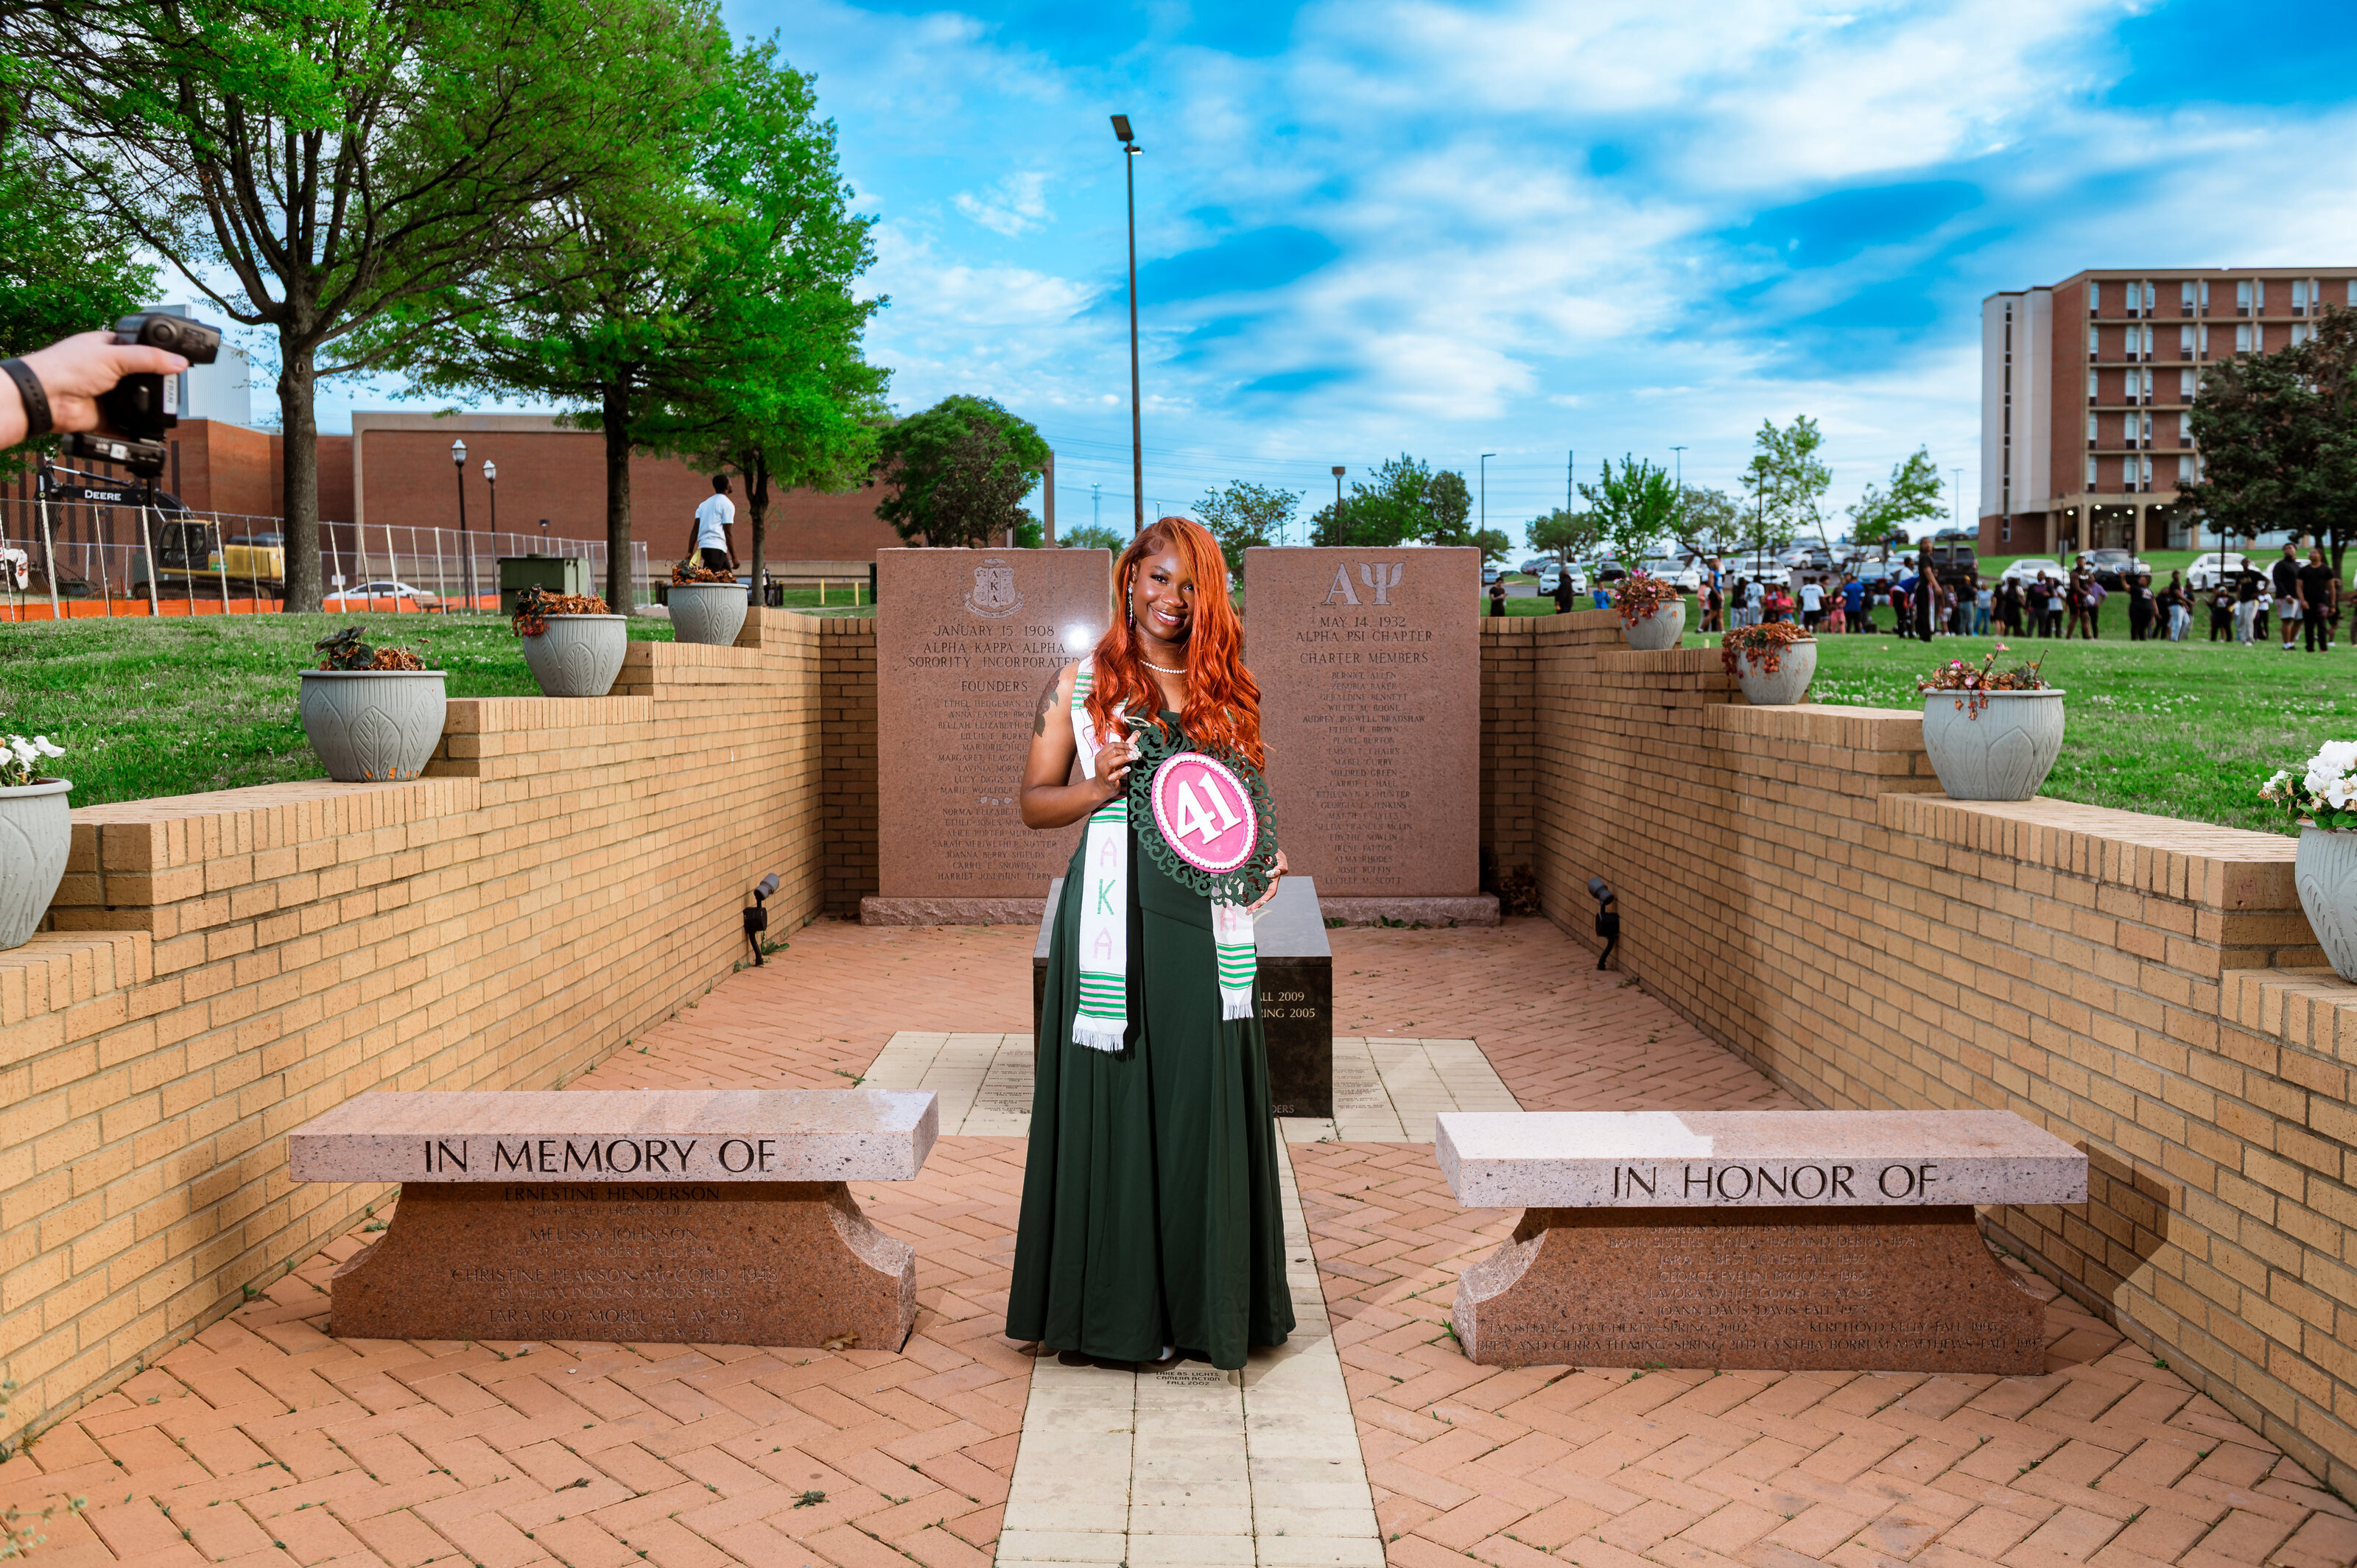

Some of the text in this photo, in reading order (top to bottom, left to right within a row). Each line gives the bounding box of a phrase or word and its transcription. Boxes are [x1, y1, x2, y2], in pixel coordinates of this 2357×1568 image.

[84, 489, 122, 502] DEERE
[1320, 616, 1346, 627] MAY
[1379, 616, 1406, 627] 1932
[932, 625, 993, 638] JANUARY
[1025, 625, 1054, 638] 1908
[1296, 631, 1433, 642] ALPHA PSI CHAPTER
[924, 642, 1065, 654] ALPHA KAPPA ALPHA
[1300, 653, 1428, 664] CHARTER MEMBERS
[1332, 672, 1397, 680] BERNICE ALLEN
[961, 681, 1028, 692] FOUNDERS
[944, 700, 1039, 708] ETHEL HEDGEMAN LYL
[949, 711, 1008, 719] ANNA EASTER
[960, 732, 1029, 741] LILLIE BURKE
[1330, 769, 1397, 777] MILDRED GREEN
[955, 776, 1004, 784] LUCY DIGGS
[941, 787, 967, 795] MARIE
[943, 808, 1021, 816] NORMA ELIZABETH
[1176, 772, 1242, 845] 41
[1329, 812, 1399, 820] MATTIE LYLES
[952, 862, 1037, 870] CARRIE SNOWDEN
[938, 872, 1052, 881] HARRIET JOSEPHINE TERRY
[1278, 991, 1304, 1002] 2009
[1290, 1008, 1316, 1018] 2005
[424, 1139, 776, 1173] IN MEMORY OF
[1613, 1165, 1938, 1200] IN HONOR OF
[505, 1187, 720, 1201] ERNESTINE HENDERSON
[608, 1206, 692, 1216] HERNANDEZ
[1650, 1223, 1757, 1234] SHARON SMITH
[529, 1228, 699, 1243] MELISSA JOHNSON
[1801, 1237, 1831, 1248] AND
[594, 1247, 678, 1258] RIDERS FALL
[452, 1268, 778, 1283] CHRISTINE PEARSON McCORD 1948
[1659, 1271, 1767, 1282] GEORGE EVELYN
[498, 1288, 634, 1298] BY VELMA DODSON
[1649, 1289, 1753, 1299] LAVORA WHITE
[488, 1309, 533, 1324] TARA
[1657, 1306, 1867, 1317] JOANN 1973
[1489, 1323, 1547, 1335] TANISHA
[1810, 1322, 1884, 1333] KERI FLOYD
[603, 1328, 646, 1339] EATON
[1477, 1340, 1601, 1351] BREA AND CIERRA
[1764, 1340, 1889, 1351] CYNTHIA BORRUM
